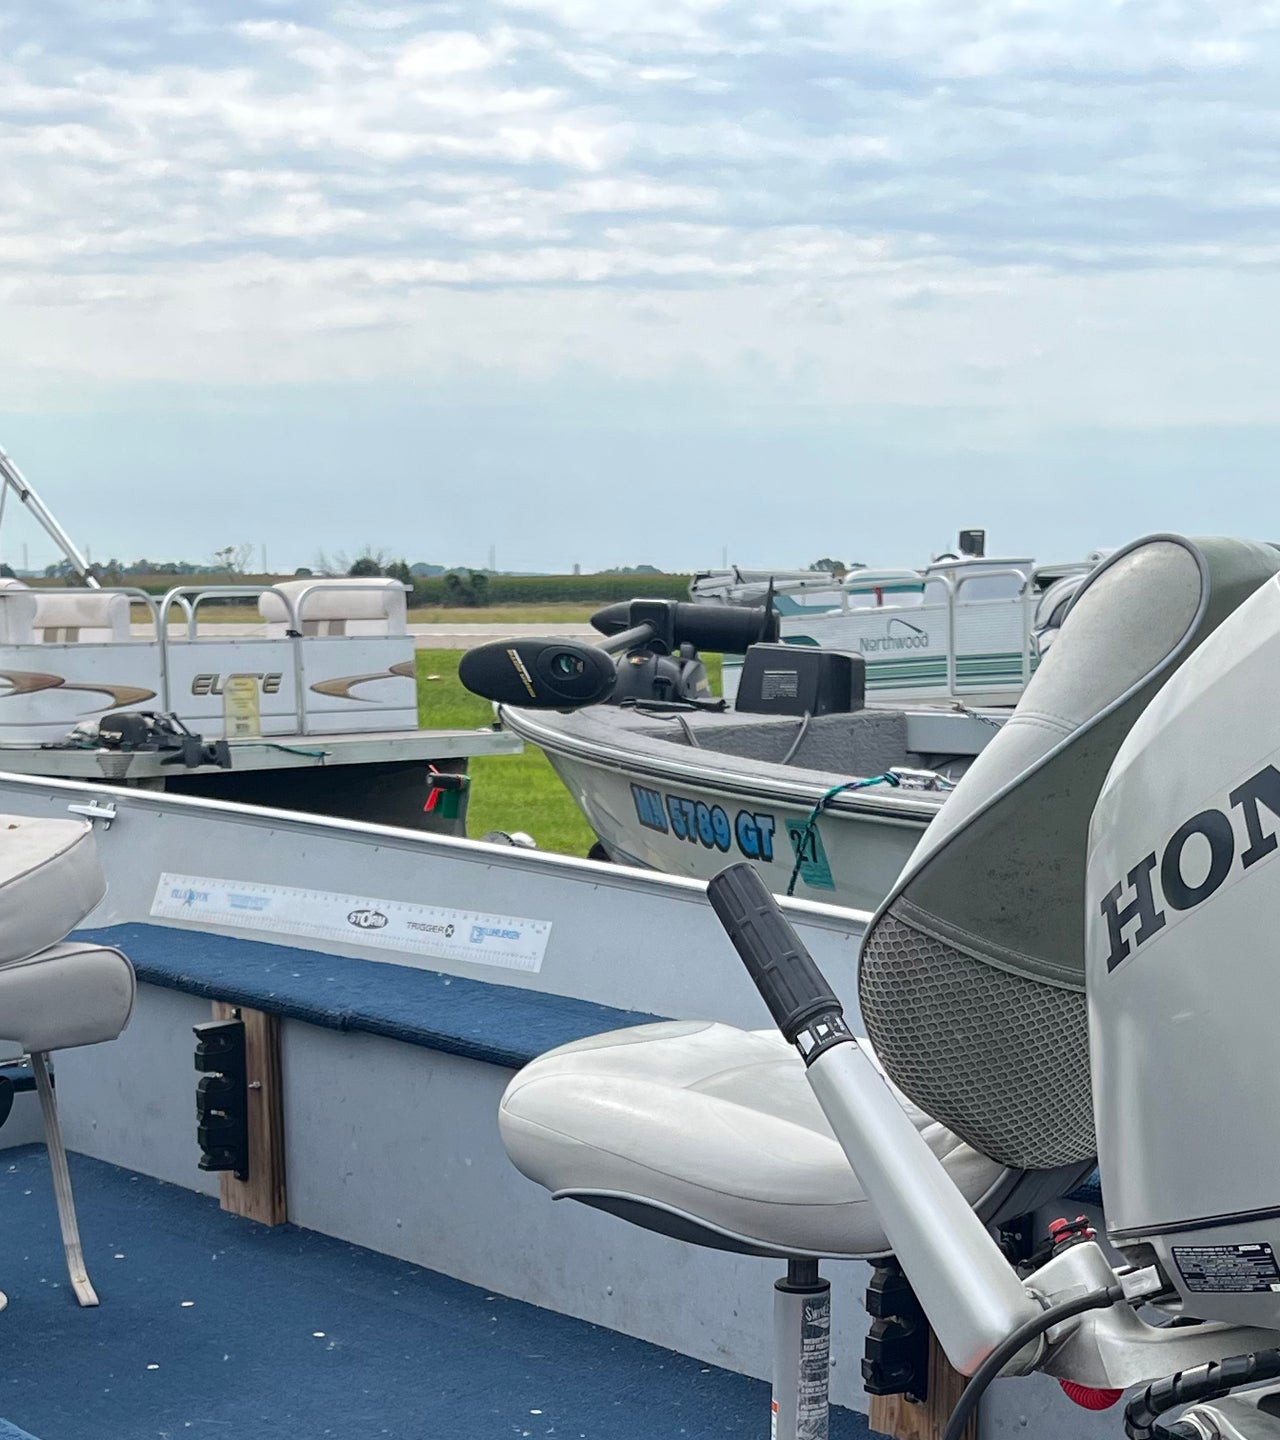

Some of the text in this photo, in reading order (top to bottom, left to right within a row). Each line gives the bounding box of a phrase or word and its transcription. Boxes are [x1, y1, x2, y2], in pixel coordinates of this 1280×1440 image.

[860, 633, 929, 652] Northwood
[191, 672, 283, 696] ELE
[630, 783, 776, 863] MN 5789 GT
[348, 910, 387, 928] STORM
